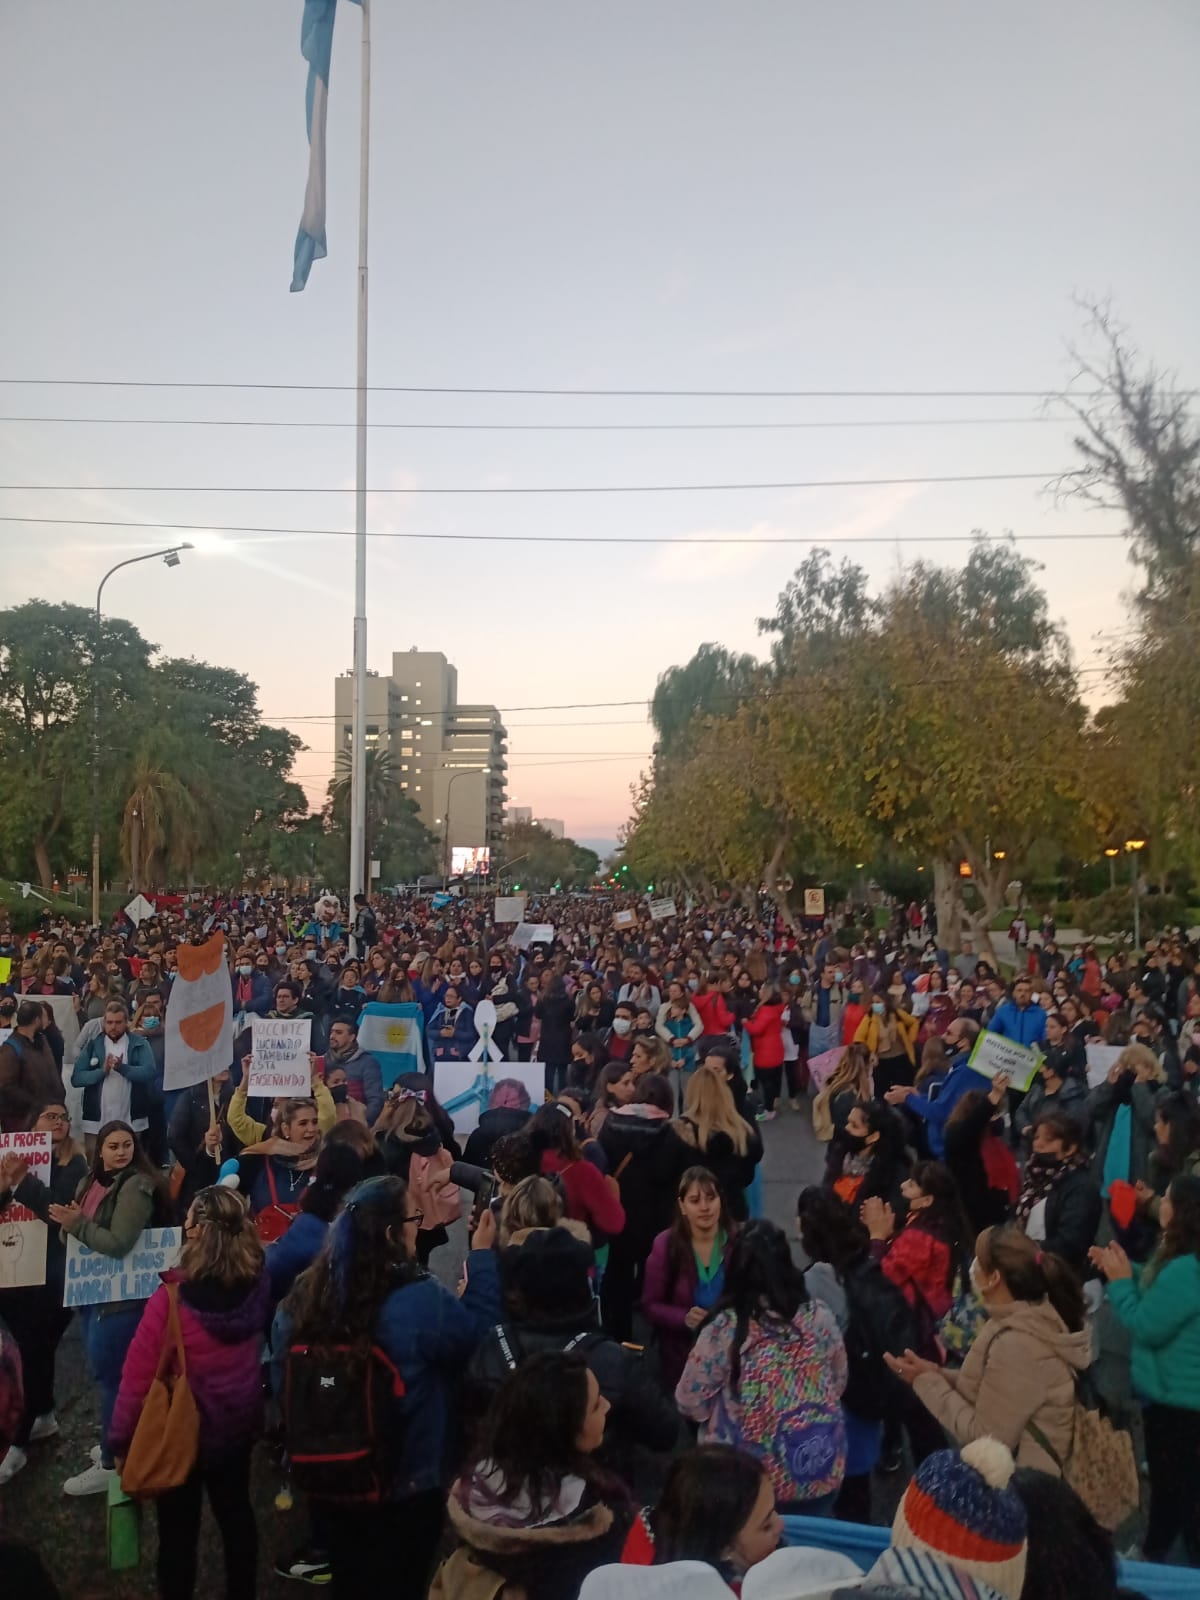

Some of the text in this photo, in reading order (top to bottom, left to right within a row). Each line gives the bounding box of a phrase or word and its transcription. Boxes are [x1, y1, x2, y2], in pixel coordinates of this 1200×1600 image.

[14, 1132, 46, 1147] PROFE
[145, 1229, 176, 1249] LA
[69, 1251, 165, 1279] LUCHA NOS
